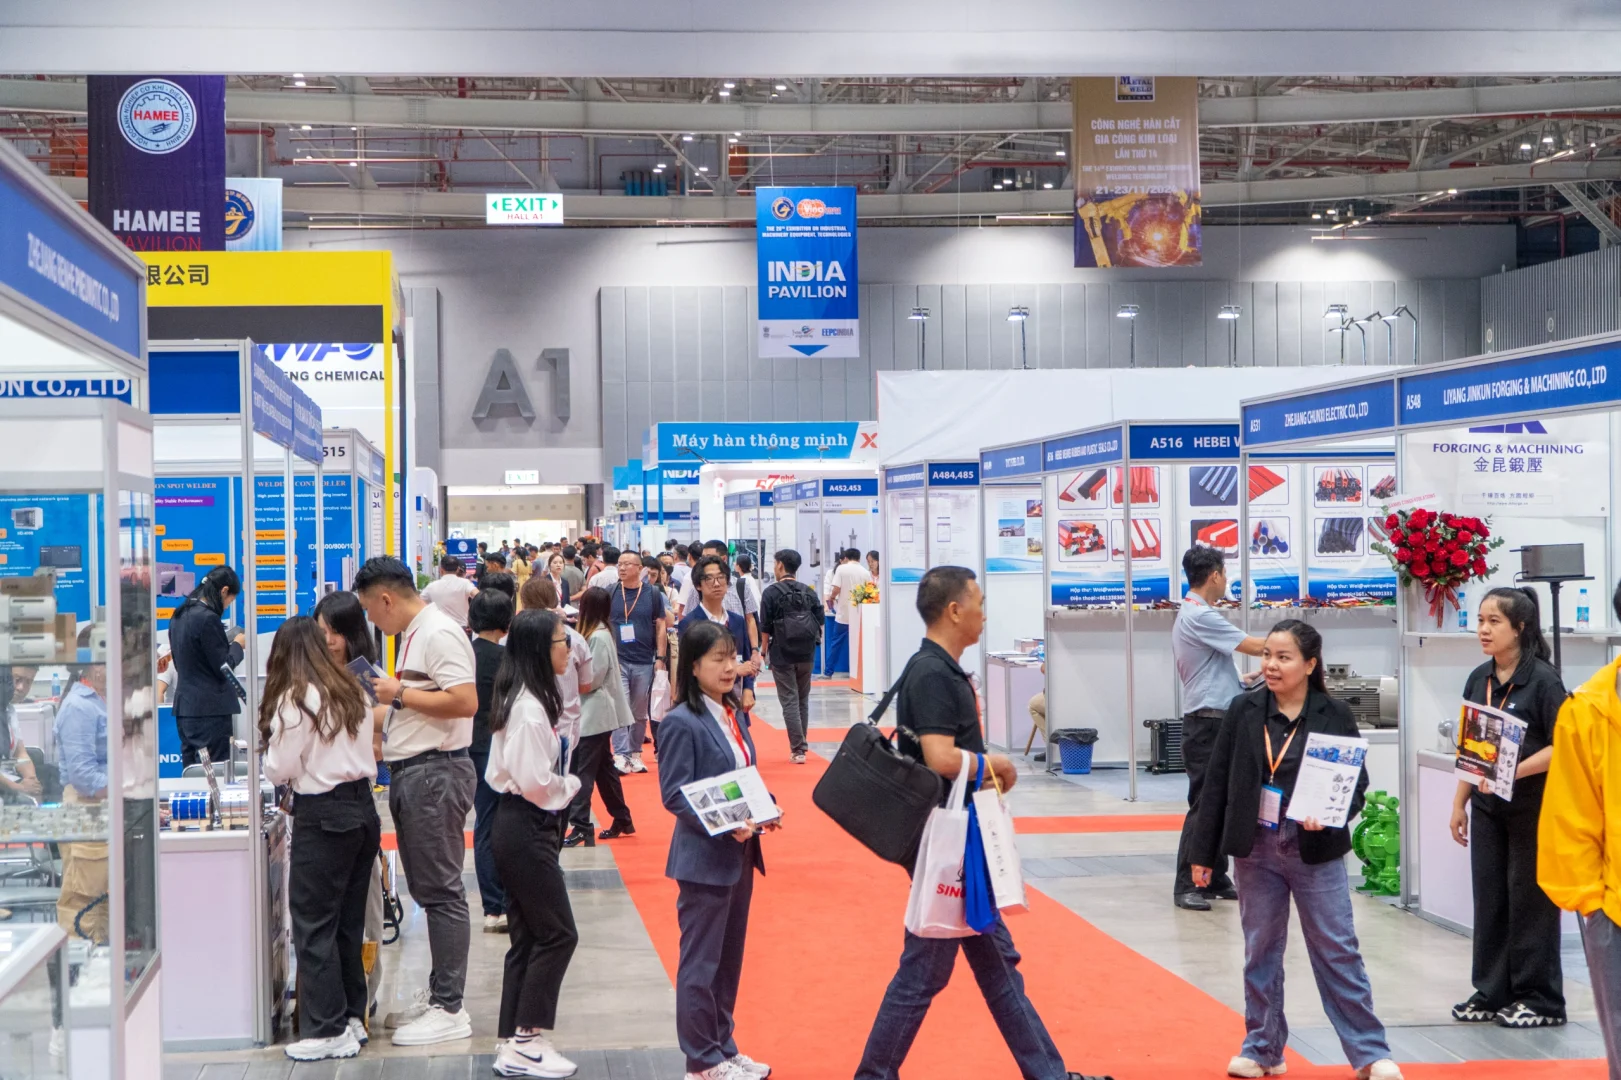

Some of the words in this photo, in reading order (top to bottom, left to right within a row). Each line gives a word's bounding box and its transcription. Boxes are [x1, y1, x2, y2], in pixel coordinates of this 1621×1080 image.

[134, 110, 179, 121] HAMEE
[1094, 134, 1109, 144] GIA
[1096, 185, 1178, 194] 21-23/11/2024
[502, 198, 547, 211] EXIT
[114, 210, 200, 232] HAMEE
[768, 261, 846, 282] INDIA
[768, 286, 847, 298] PAVILION
[314, 371, 384, 381] CHEMICAL
[472, 348, 571, 428] A1
[1406, 394, 1421, 410] A548
[1443, 387, 1466, 406] LIYANG
[1467, 383, 1491, 403] JINKUN
[1492, 378, 1522, 399] FORGING
[1524, 380, 1530, 394] &
[1531, 372, 1574, 394] MACHINING
[1250, 419, 1260, 432] A531
[1284, 412, 1307, 427] ZHEJIANG
[1326, 404, 1348, 421] ELECTRIC
[672, 433, 709, 449] Máy
[713, 434, 745, 447] hàn
[750, 434, 800, 449] thông
[804, 433, 847, 447] minh
[1150, 438, 1183, 448] A516
[1194, 436, 1230, 448] HEBEI
[1433, 443, 1491, 454] FORGING
[1495, 444, 1503, 454] &
[1507, 444, 1584, 454] MACHINING
[932, 471, 974, 480] A484,485
